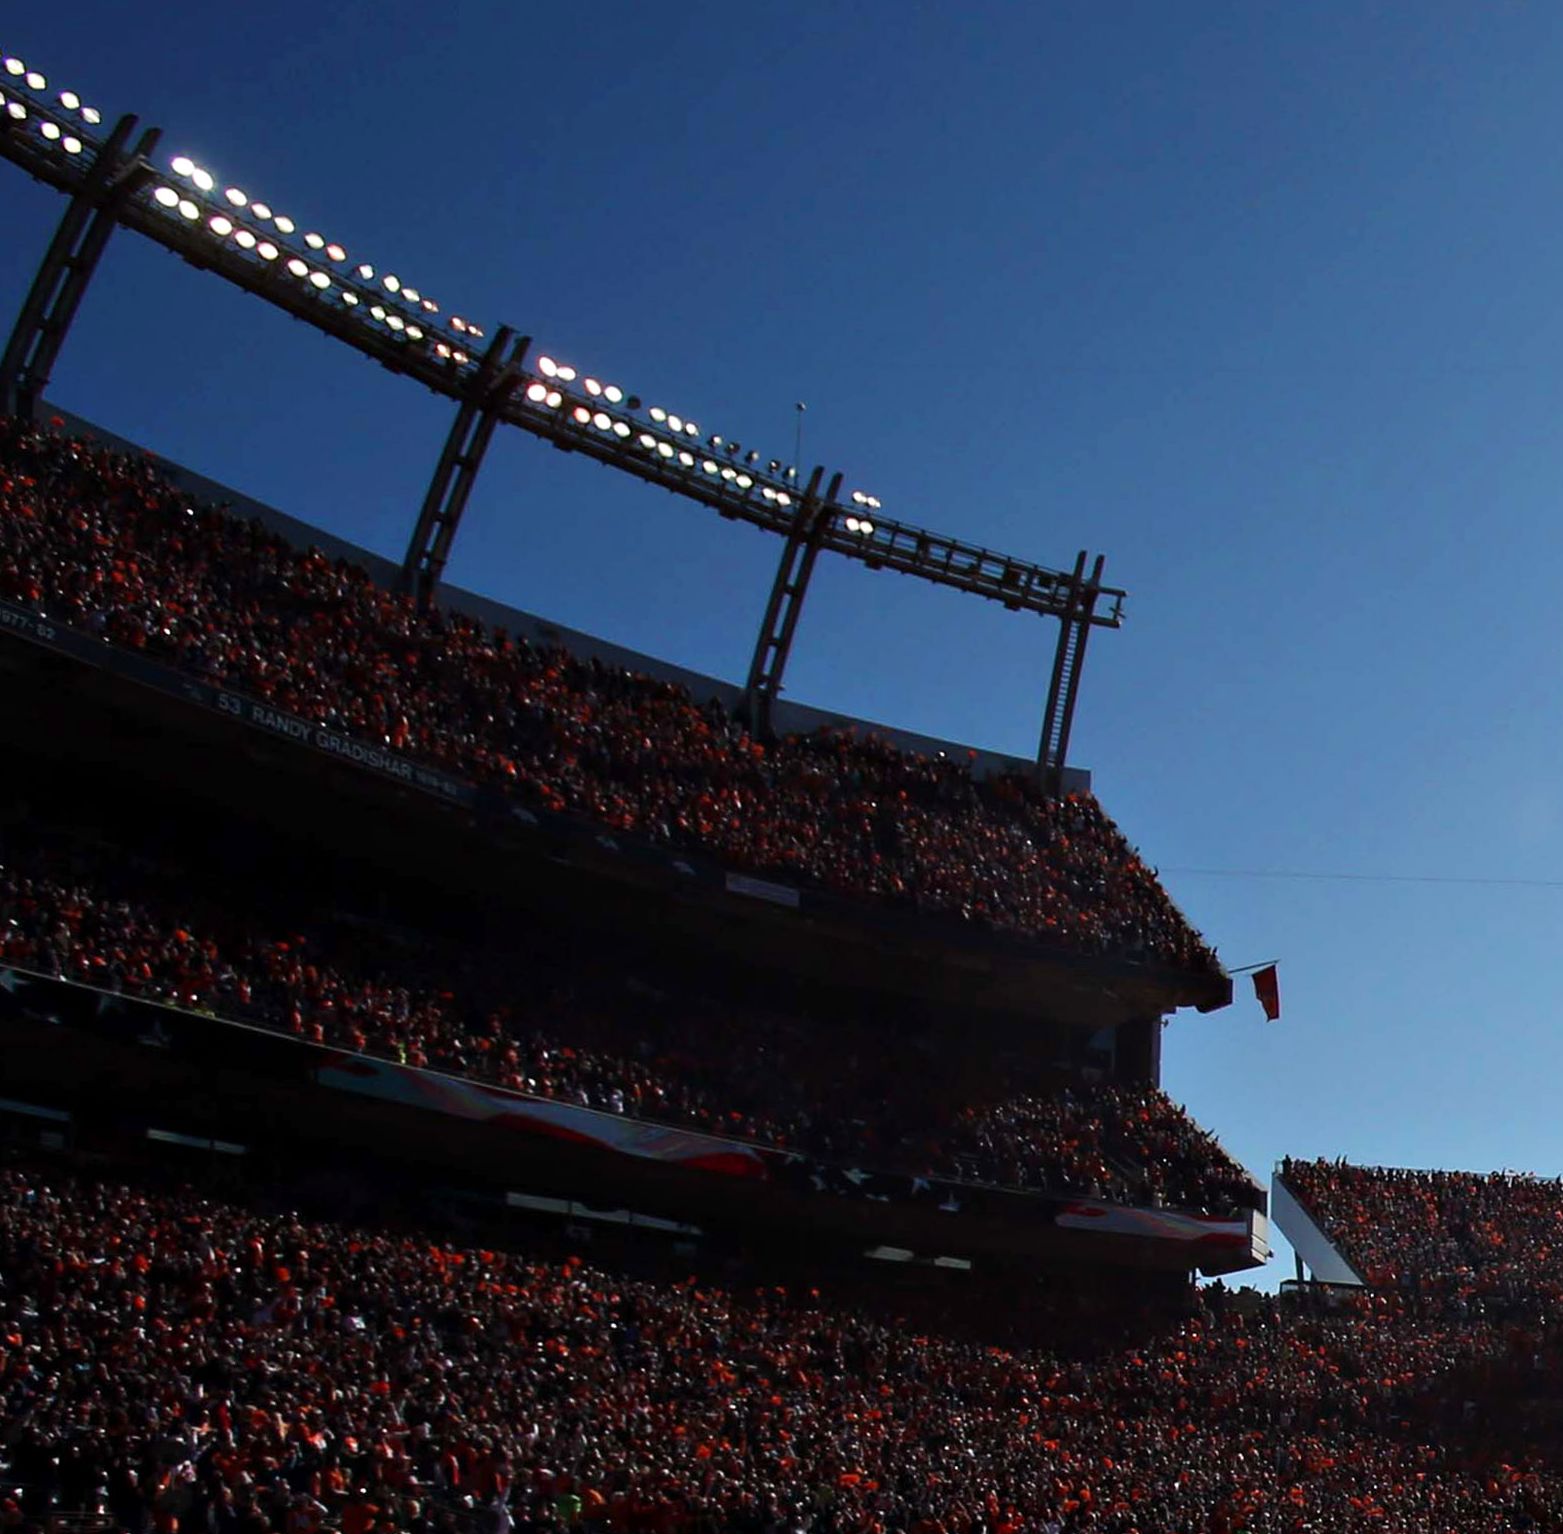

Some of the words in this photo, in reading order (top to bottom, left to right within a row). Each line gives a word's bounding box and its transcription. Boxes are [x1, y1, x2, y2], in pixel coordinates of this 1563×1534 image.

[218, 692, 242, 716] 53
[252, 704, 312, 742] RANDY
[315, 731, 415, 782] GRADISHAR
